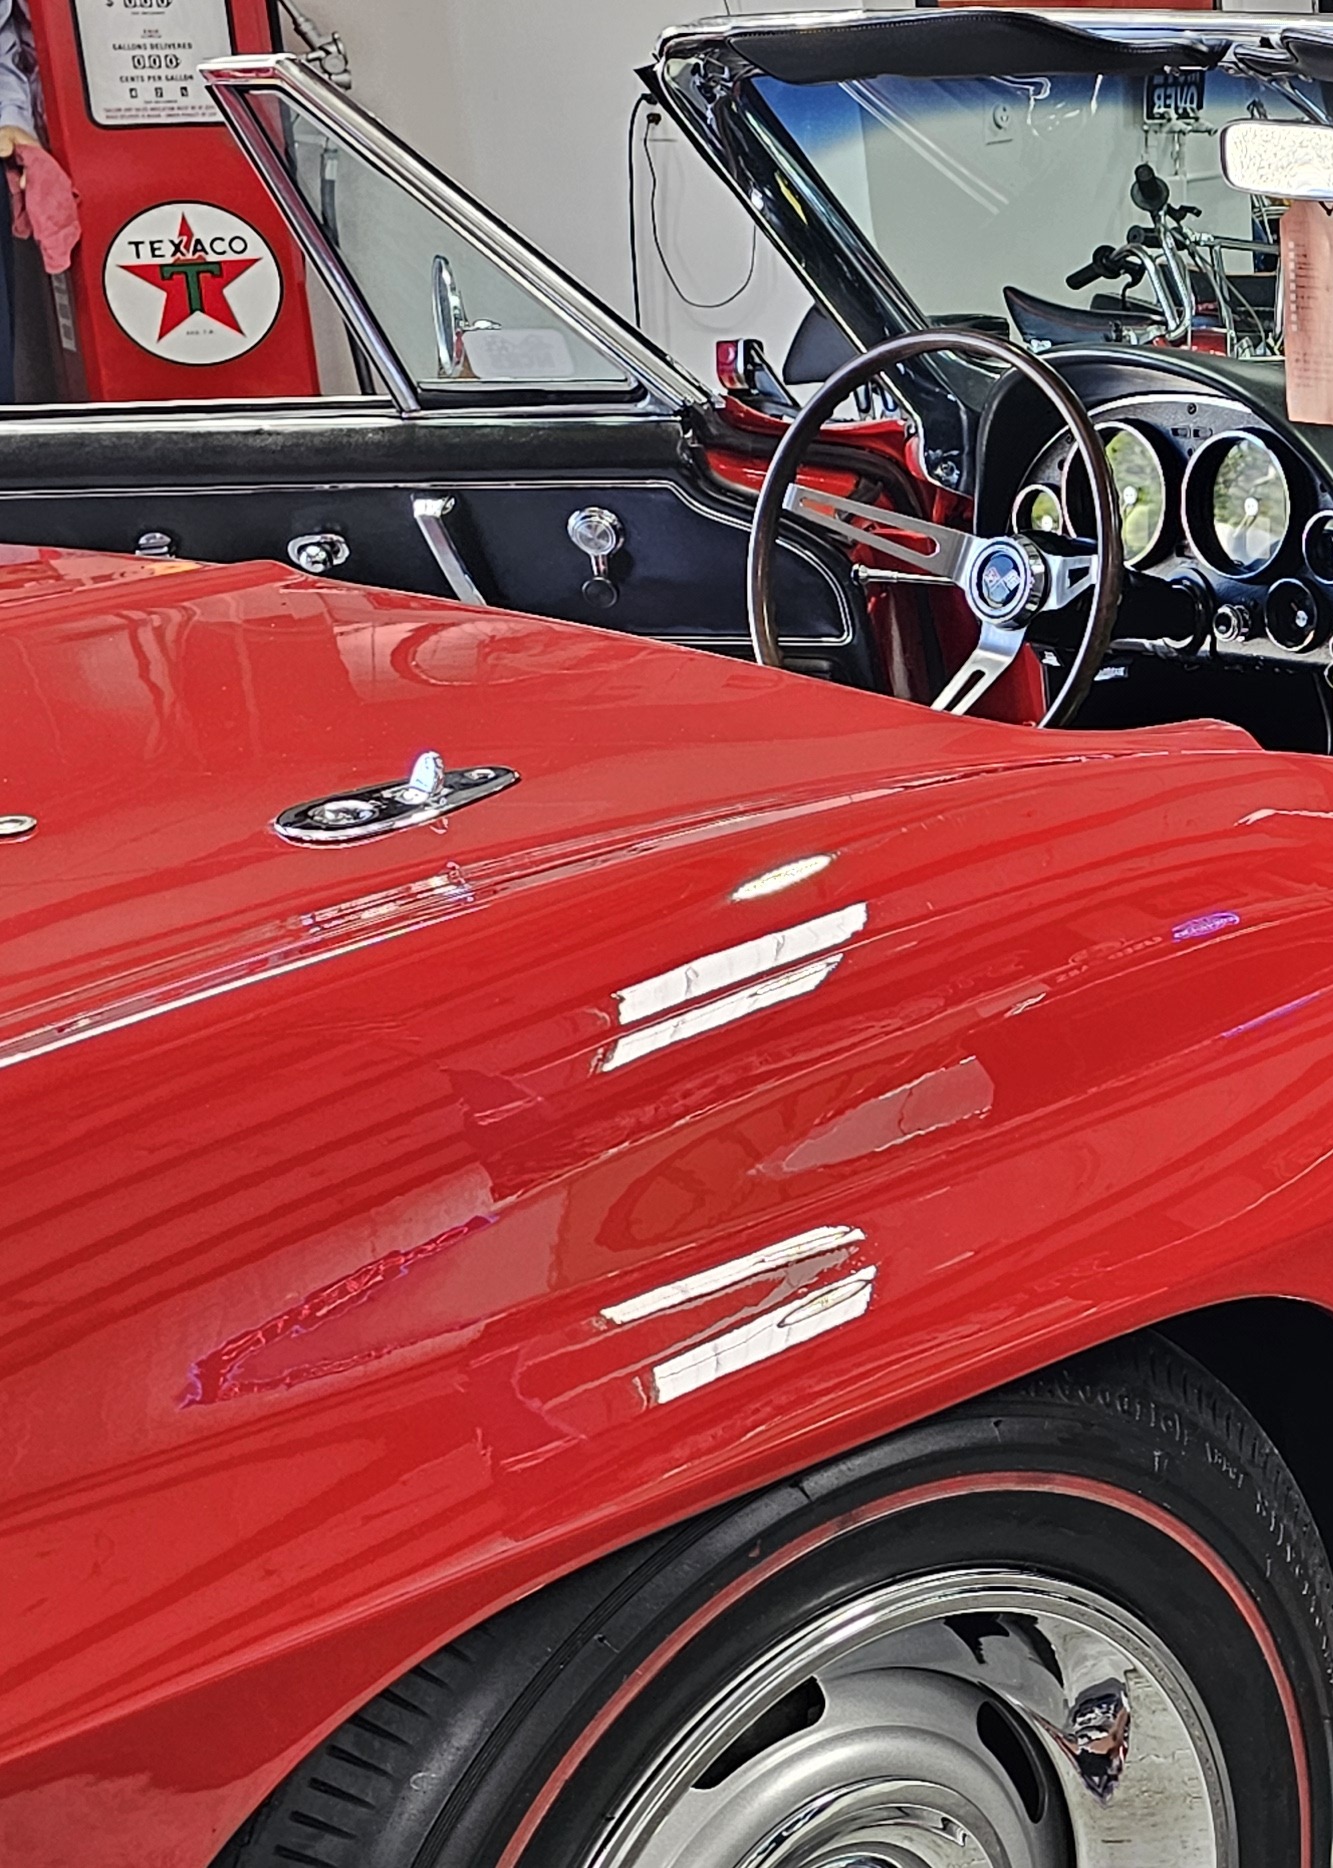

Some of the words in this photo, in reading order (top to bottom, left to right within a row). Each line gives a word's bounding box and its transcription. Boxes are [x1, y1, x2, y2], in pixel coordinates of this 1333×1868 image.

[112, 43, 148, 51] GALLONS
[149, 42, 193, 50] DELIVERED
[119, 75, 145, 83] CENTS
[147, 74, 162, 82] PER
[165, 74, 195, 82] GALLON
[128, 236, 249, 259] TEXACO
[159, 261, 224, 315] T
